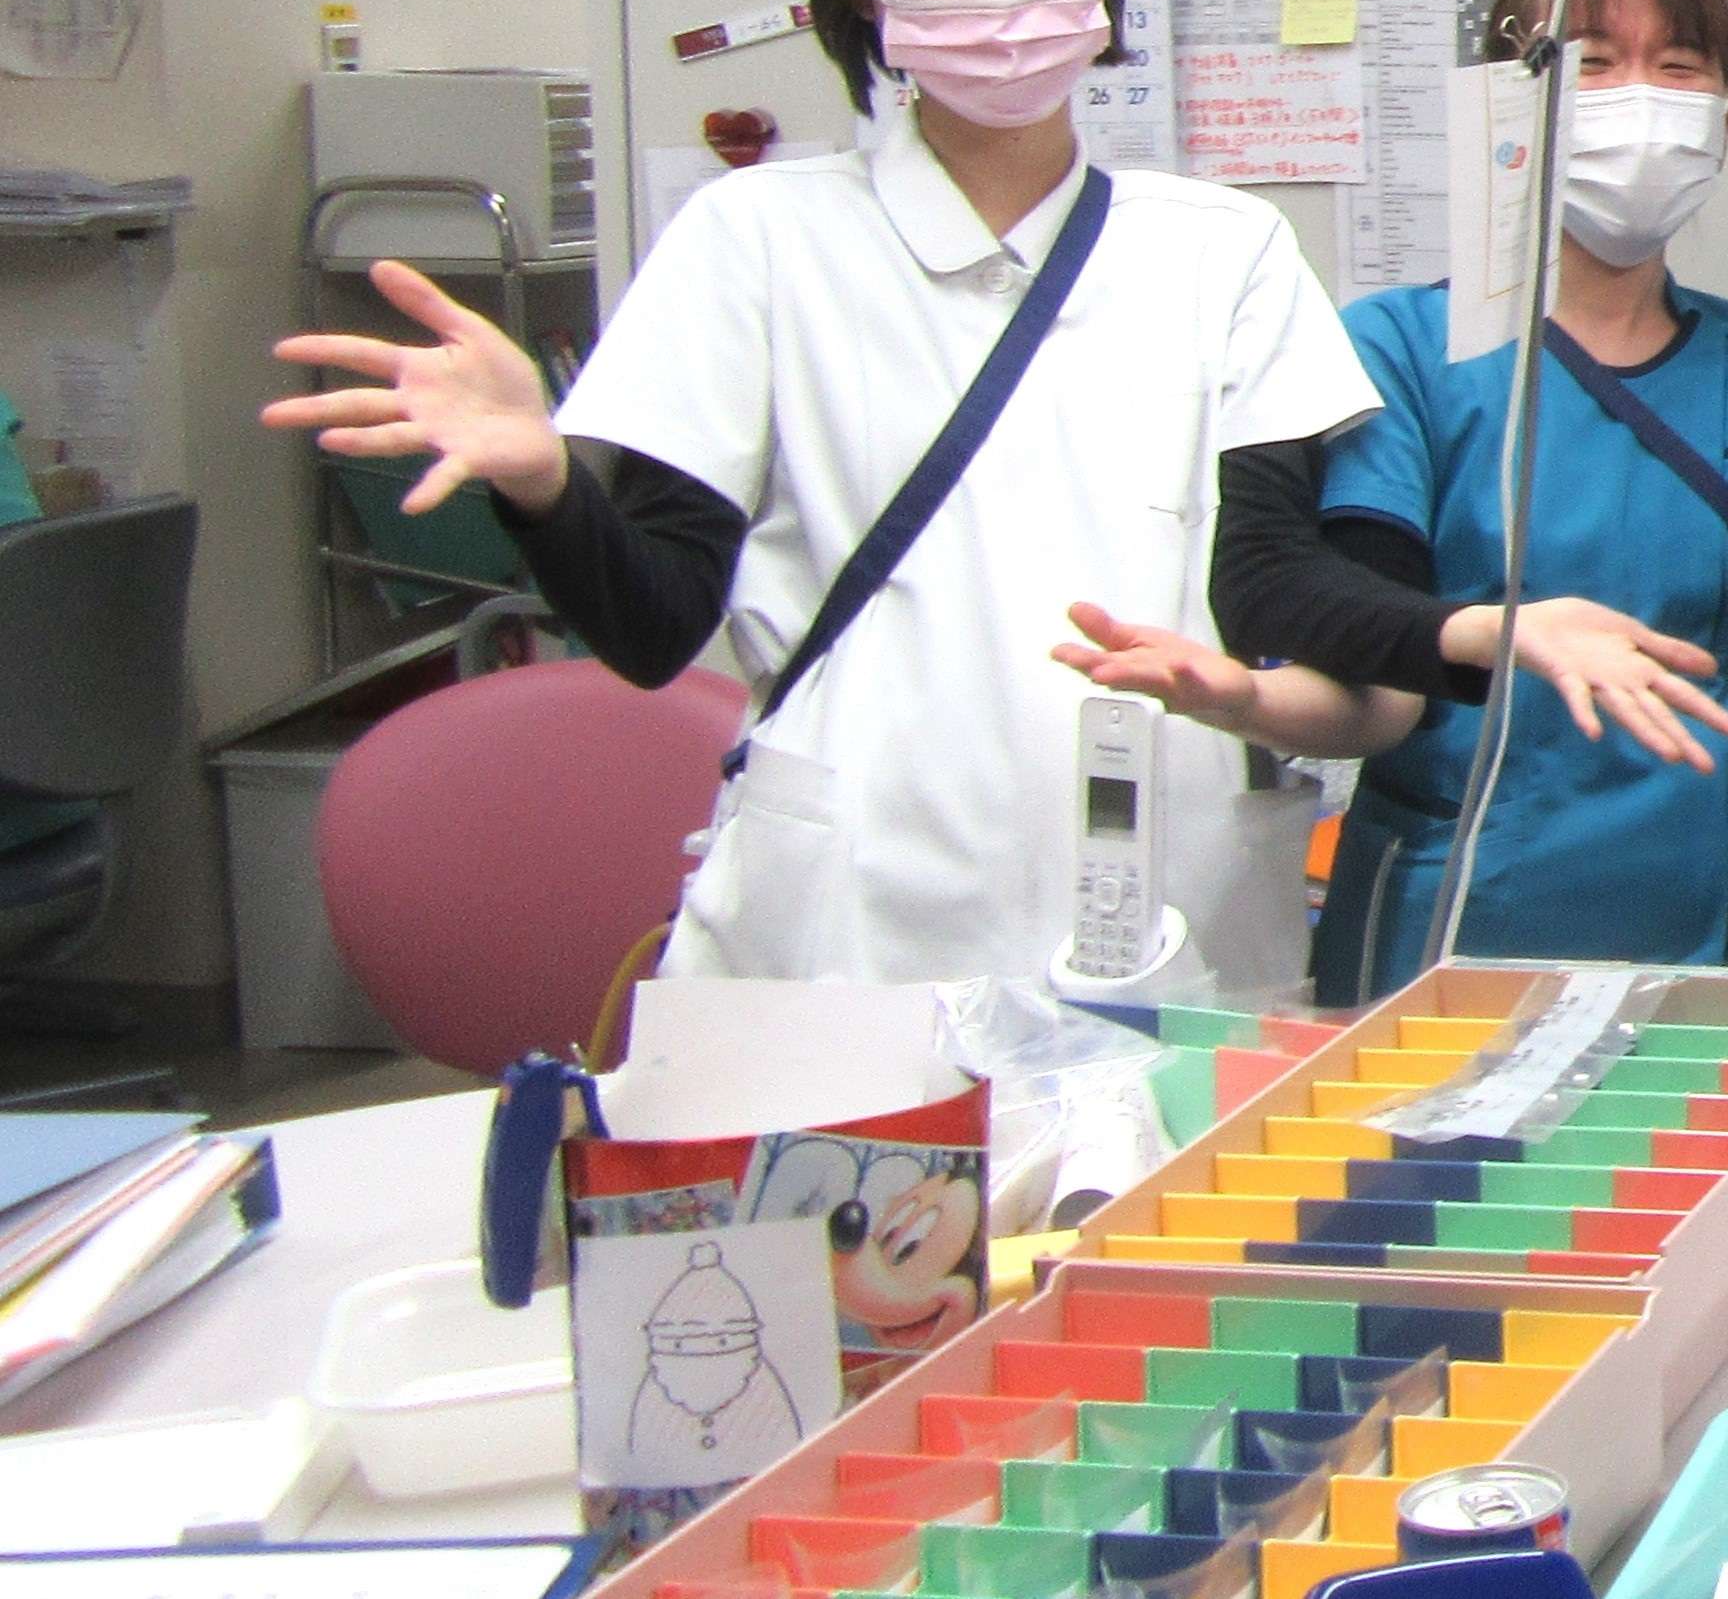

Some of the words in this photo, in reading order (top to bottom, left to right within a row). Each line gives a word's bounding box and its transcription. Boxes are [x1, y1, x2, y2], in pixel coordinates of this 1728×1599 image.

[1125, 10, 1147, 30] 13
[1088, 87, 1110, 106] 26
[1127, 86, 1150, 105] 27
